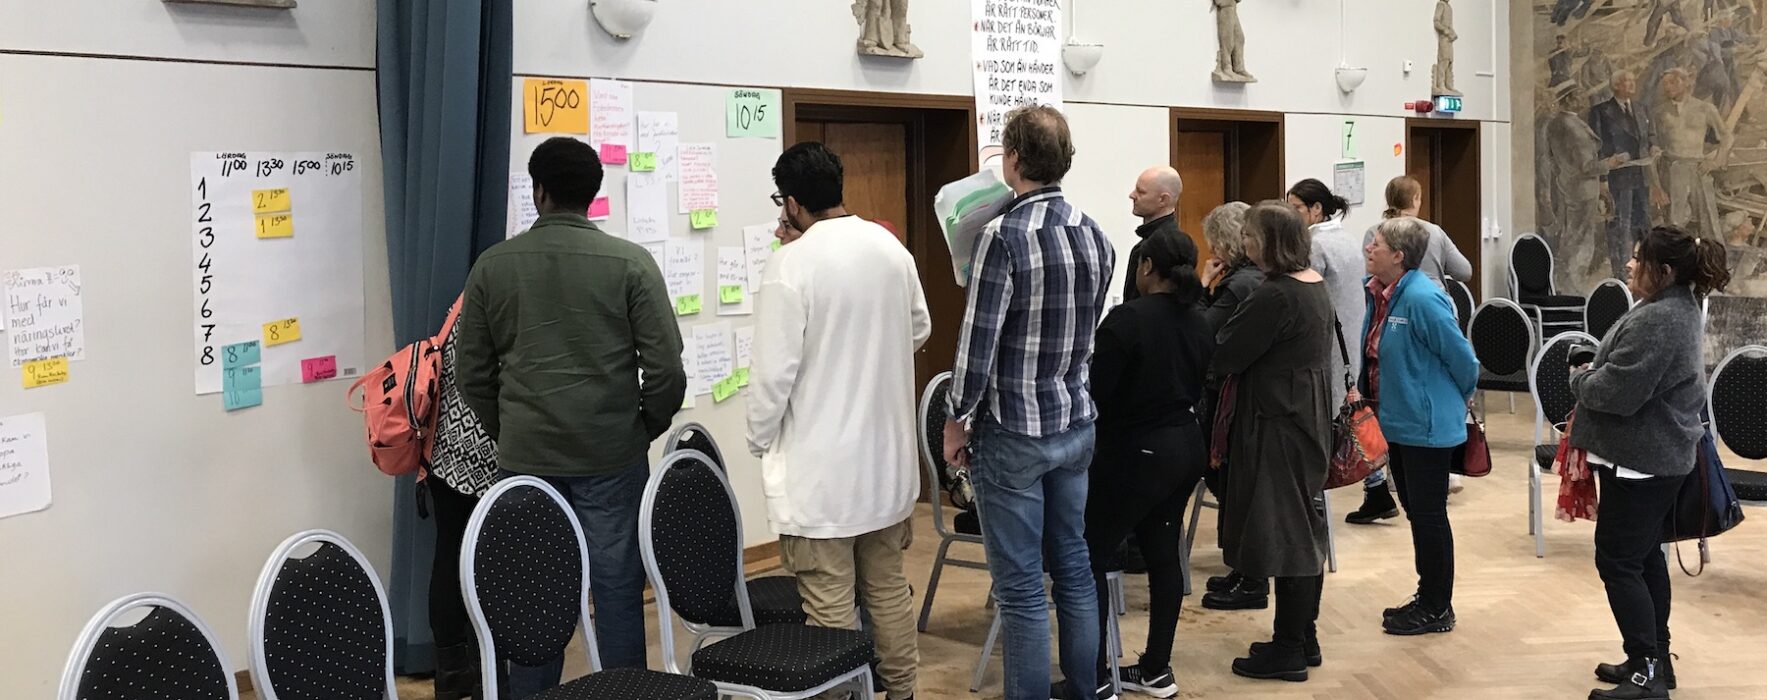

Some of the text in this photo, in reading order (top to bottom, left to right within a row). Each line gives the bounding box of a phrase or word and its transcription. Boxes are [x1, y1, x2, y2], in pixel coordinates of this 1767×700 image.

[981, 19, 1056, 40] NÄR DET ÄN BÖRJAR
[987, 35, 999, 52] ÄR
[983, 58, 1054, 75] VAD SOM ÄN HÄNDER
[988, 74, 1053, 95] ÄR DET ENDA SOM
[534, 86, 580, 127] 1500
[990, 94, 1012, 107] KUNDE
[736, 103, 767, 130] 1015
[987, 110, 1002, 125] NÄR
[1345, 121, 1354, 150] 7
[257, 158, 283, 177] 1330
[293, 160, 321, 175] 1500
[331, 161, 354, 175] 1015
[198, 177, 205, 200] 1
[257, 193, 266, 208] 2
[198, 203, 212, 222] 2
[261, 220, 265, 233] 1
[199, 227, 214, 248] 3
[198, 252, 211, 273] 4
[200, 275, 213, 294] 5
[10, 294, 30, 314] Hur
[36, 293, 52, 316] får
[201, 299, 212, 318] 6
[11, 313, 35, 328] med
[201, 324, 215, 342] 7
[270, 325, 280, 341] 8
[200, 346, 214, 365] 8
[227, 346, 237, 363] 8
[27, 365, 36, 379] 9
[228, 369, 235, 388] 9
